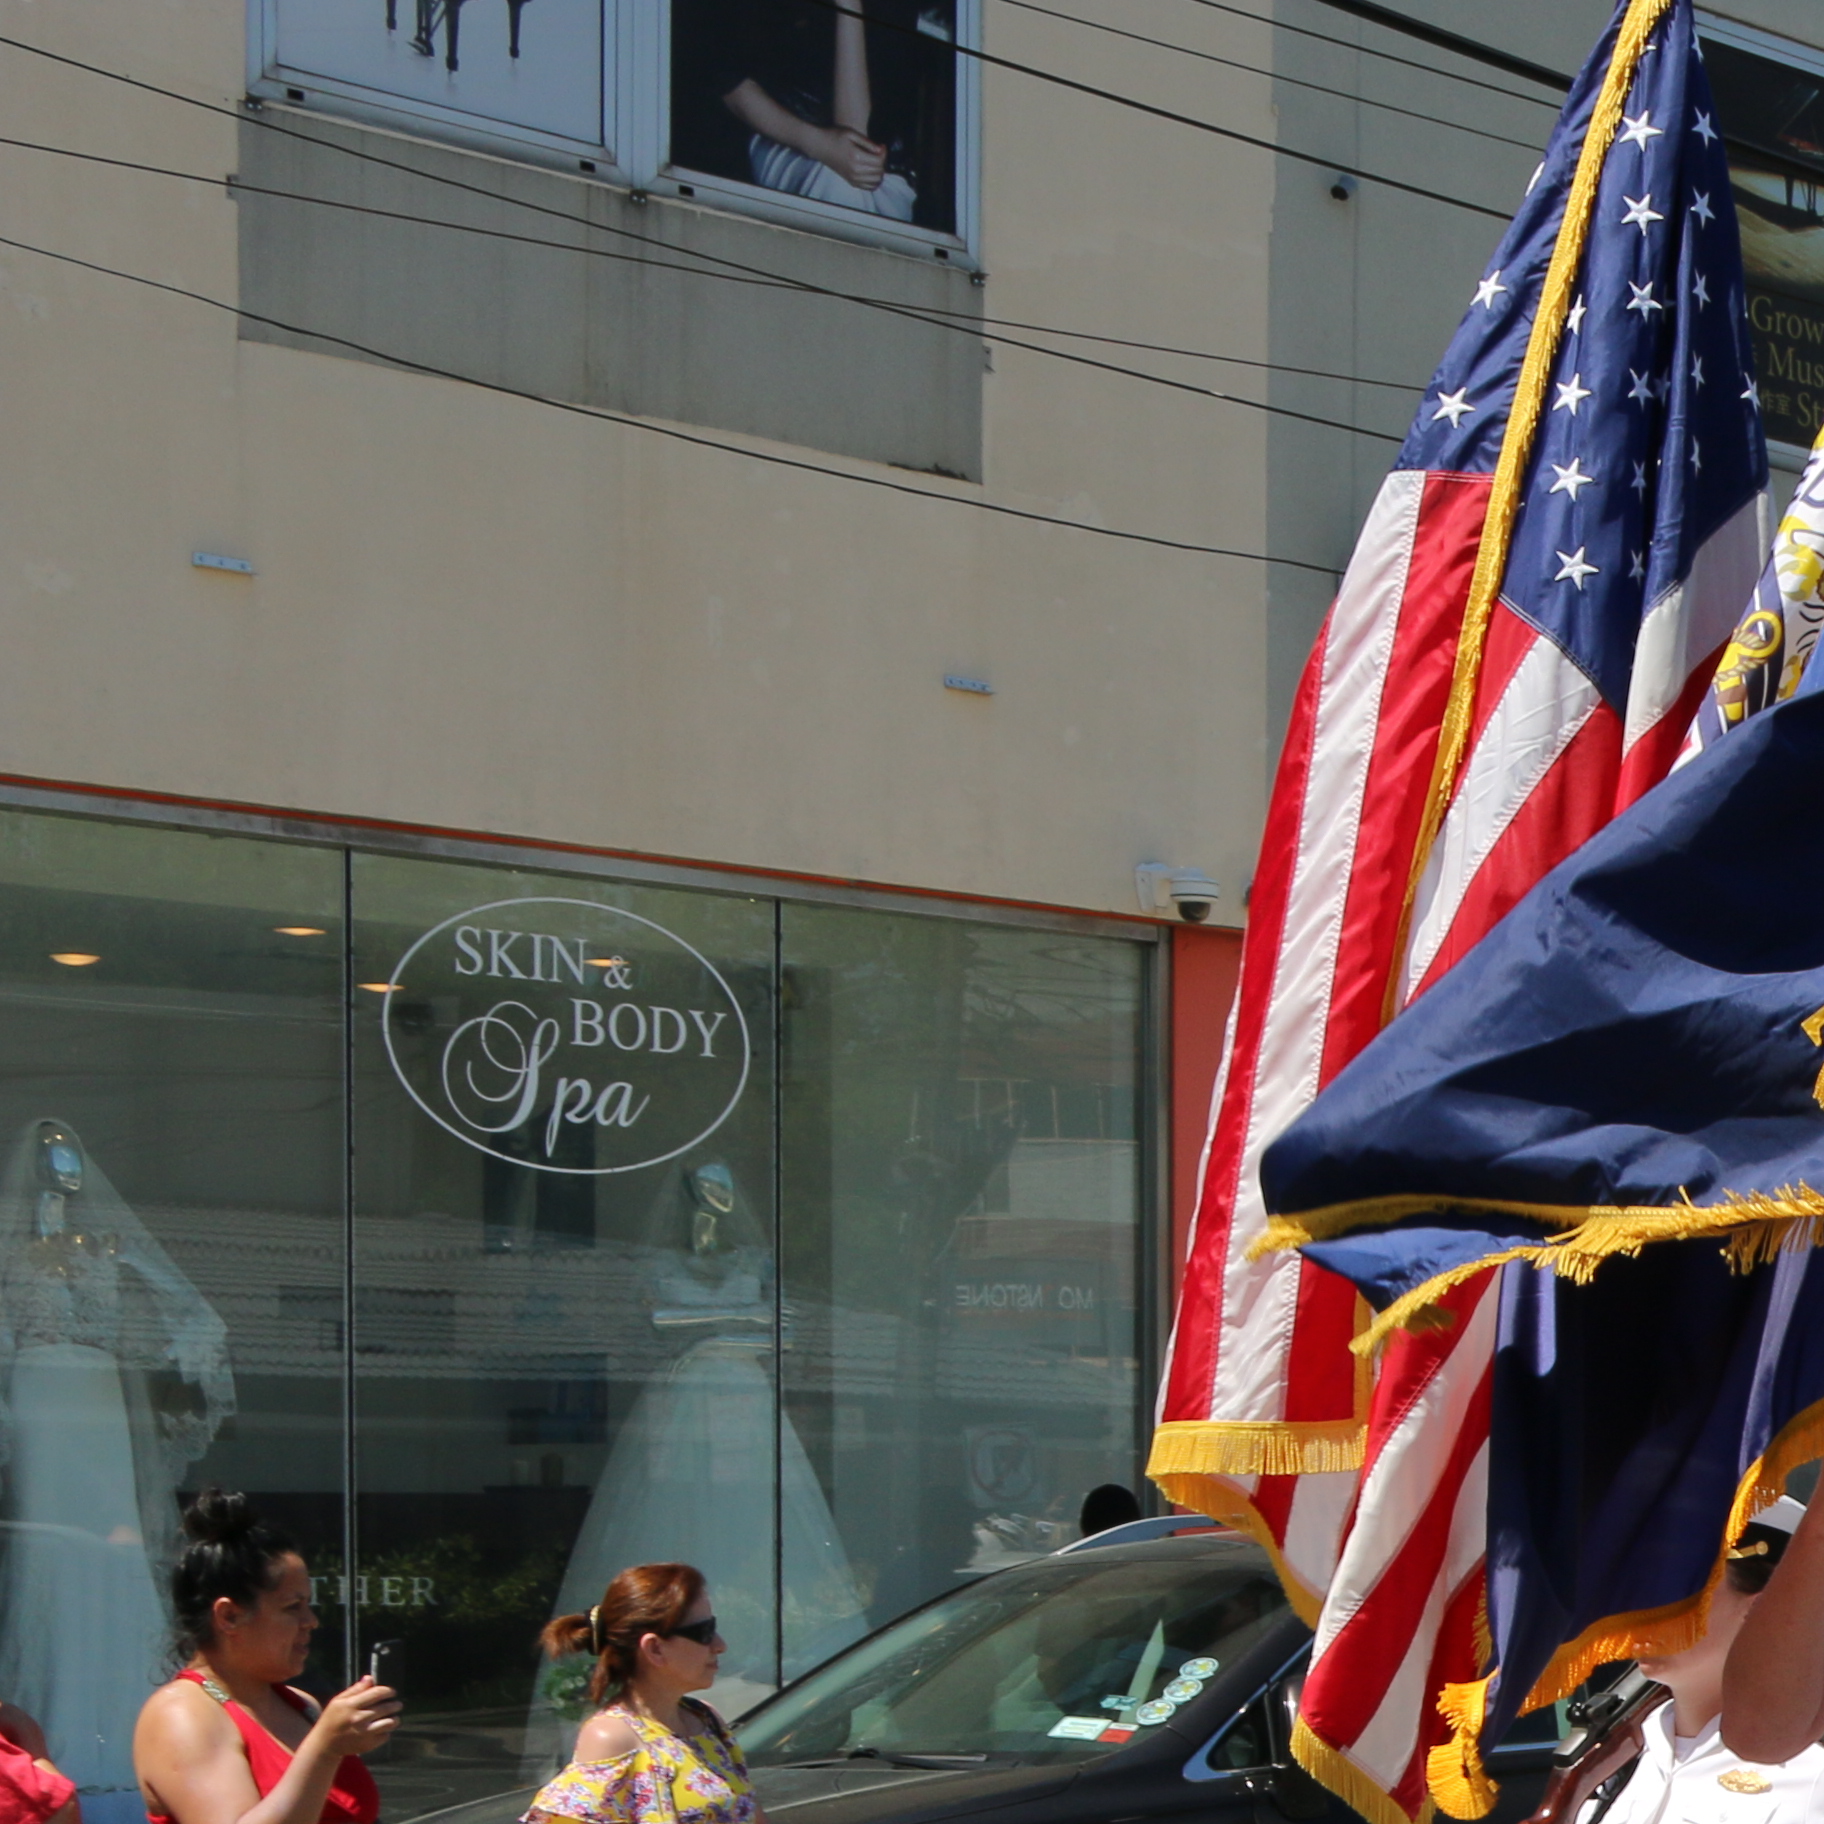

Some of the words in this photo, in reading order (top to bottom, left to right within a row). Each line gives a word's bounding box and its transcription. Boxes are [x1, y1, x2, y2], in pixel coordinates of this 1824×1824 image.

[455, 926, 588, 984] SKIN
[604, 955, 632, 990] &
[570, 998, 727, 1058] BODY
[443, 1001, 650, 1158] Spa
[307, 1576, 440, 1607] THER
